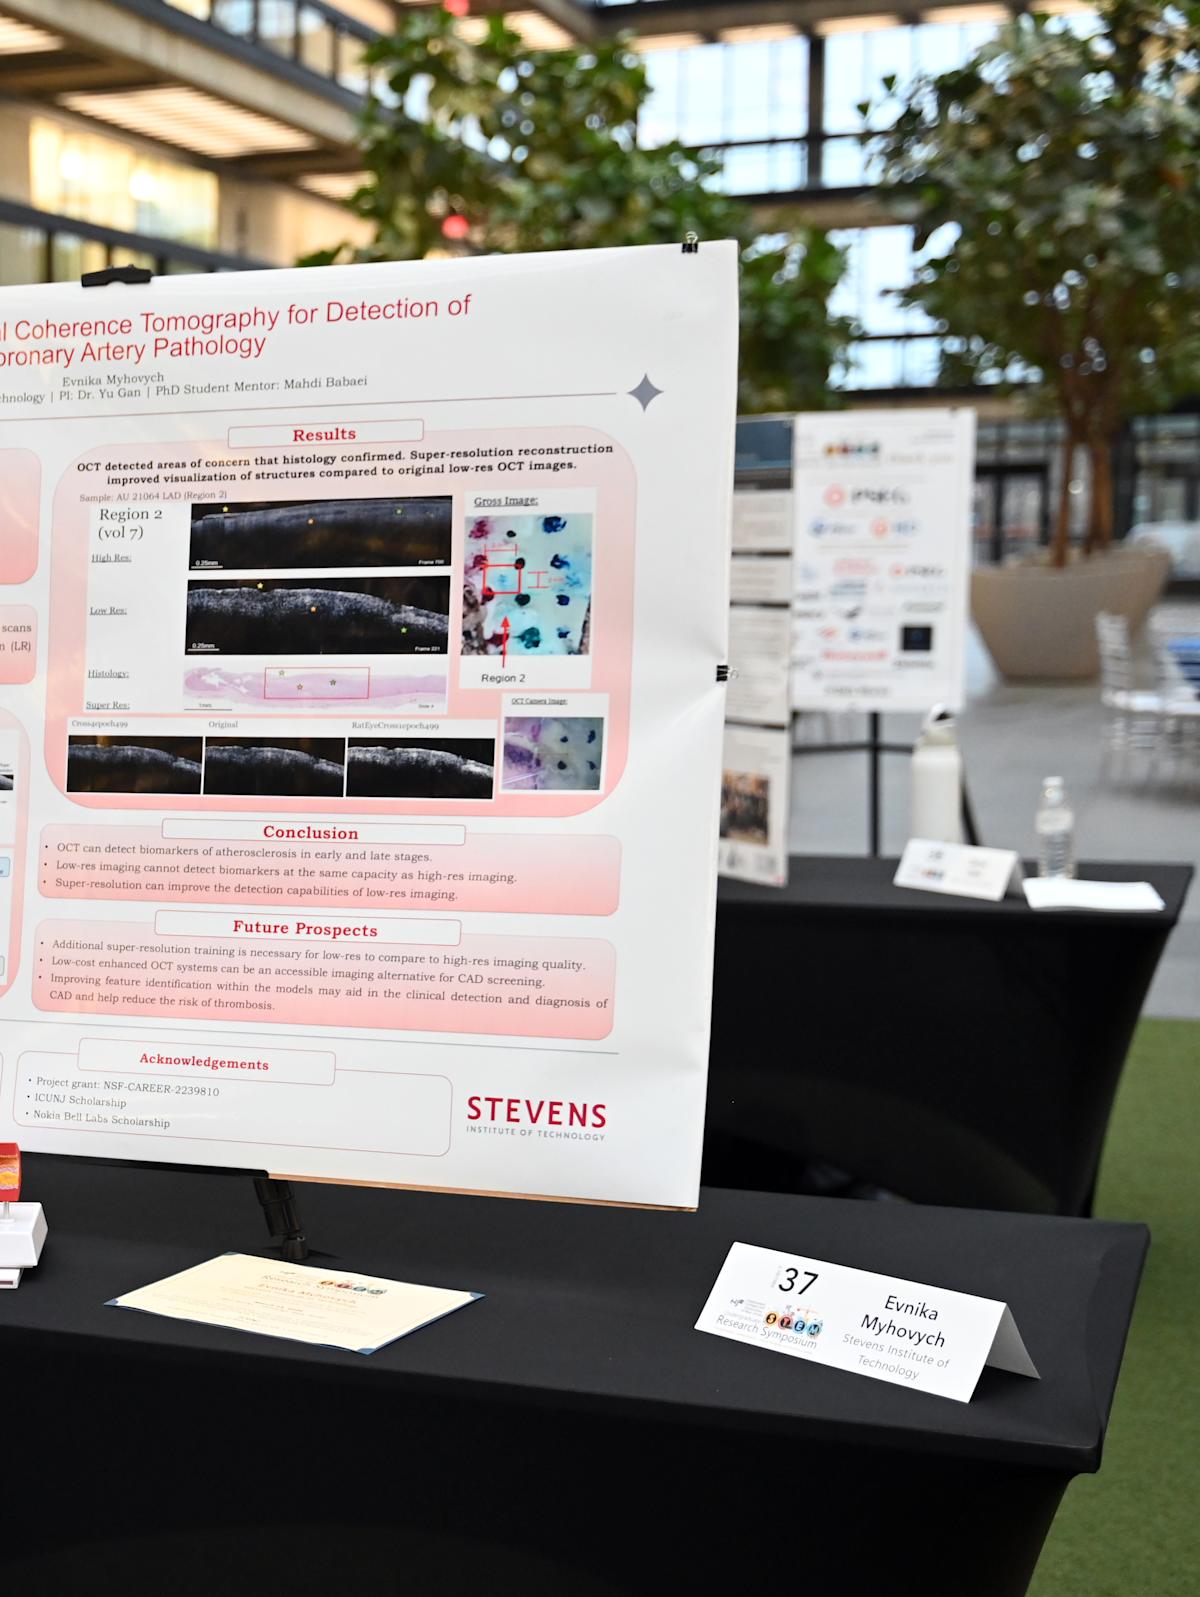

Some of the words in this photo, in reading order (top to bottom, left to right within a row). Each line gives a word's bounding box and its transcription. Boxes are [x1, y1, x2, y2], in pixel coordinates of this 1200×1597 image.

[15, 318, 132, 340] Coherence
[141, 306, 279, 334] Tomography
[287, 303, 318, 324] for
[326, 298, 438, 322] Detection
[447, 293, 472, 316] of
[80, 341, 146, 365] Artery
[154, 335, 266, 358] Pathology
[59, 389, 73, 400] PI:
[77, 388, 94, 400] Dr.
[98, 387, 114, 399] Yu
[117, 386, 141, 398] Gan
[155, 383, 180, 396] PhD
[183, 381, 229, 394] Student
[234, 379, 279, 392] Mentor:
[283, 376, 322, 390] Mahdi
[325, 374, 367, 388] Babaei
[61, 374, 102, 387] Evnika
[106, 371, 164, 387] Myhovych
[292, 426, 356, 442] Results
[76, 462, 101, 472] OCT
[104, 460, 153, 471] detected
[156, 461, 187, 469] areas
[189, 458, 202, 468] of
[204, 458, 250, 467] concern
[254, 455, 278, 465] that
[282, 452, 337, 467] histology
[340, 450, 405, 462] confirmed.
[409, 446, 513, 462] Super-resolution
[517, 442, 613, 456] reconstruction
[107, 474, 160, 487] improved
[162, 471, 236, 483] visualization
[239, 470, 252, 480] of
[255, 469, 315, 480] structures
[318, 465, 377, 480] compared
[381, 466, 394, 475] to
[397, 463, 445, 477] original
[448, 461, 493, 473] low-res
[496, 460, 525, 471] OCT
[528, 459, 576, 473] images.
[473, 496, 502, 508] Gross
[504, 495, 539, 507] Image:
[99, 507, 149, 523] Region
[153, 509, 162, 519] 2
[97, 524, 125, 540] (vol
[129, 525, 143, 540] 7)
[90, 552, 113, 563] High
[114, 553, 132, 563] Res:
[89, 606, 108, 616] Low
[109, 605, 127, 616] Res:
[87, 668, 129, 679] Histology:
[480, 673, 516, 684] Region
[518, 673, 526, 682] 2
[85, 699, 111, 711] Super
[112, 700, 130, 710] Res:
[208, 720, 238, 729] Original
[263, 824, 358, 840] Conclusion
[56, 842, 80, 852] OCT
[82, 845, 101, 853] can
[104, 843, 136, 854] detect
[139, 844, 199, 856] biomarkers
[201, 846, 214, 856] of
[215, 846, 297, 858] atherosclerosis
[300, 848, 311, 859] in
[314, 848, 342, 862] early
[344, 849, 366, 860] and
[369, 850, 391, 861] late
[393, 852, 432, 864] stages.
[232, 919, 289, 934] Future
[295, 922, 377, 940] Prospects
[139, 1053, 268, 1072] Acknowledgements
[36, 1075, 69, 1089] Project
[71, 1079, 100, 1091] grant:
[103, 1080, 220, 1097] NSF-CAREER-2239810
[34, 1092, 66, 1104] ICUNJ
[68, 1095, 127, 1110] Scholarship
[33, 1109, 61, 1120] Nokia
[63, 1111, 82, 1121] Bell
[84, 1112, 108, 1123] Labs
[111, 1114, 171, 1130] Scholarship
[467, 1096, 606, 1128] STEVENS
[466, 1125, 515, 1136] INSTITUTE
[537, 1130, 606, 1141] TECHNOLOGY
[778, 1267, 819, 1295] 37
[884, 1295, 939, 1321] Evnika
[716, 1313, 759, 1335] Research
[760, 1326, 818, 1350] Symposium
[860, 1314, 946, 1348] Myhovych
[842, 1333, 885, 1353] Stevens
[887, 1344, 934, 1365] Institute
[936, 1356, 951, 1370] of
[857, 1354, 920, 1381] Technology
